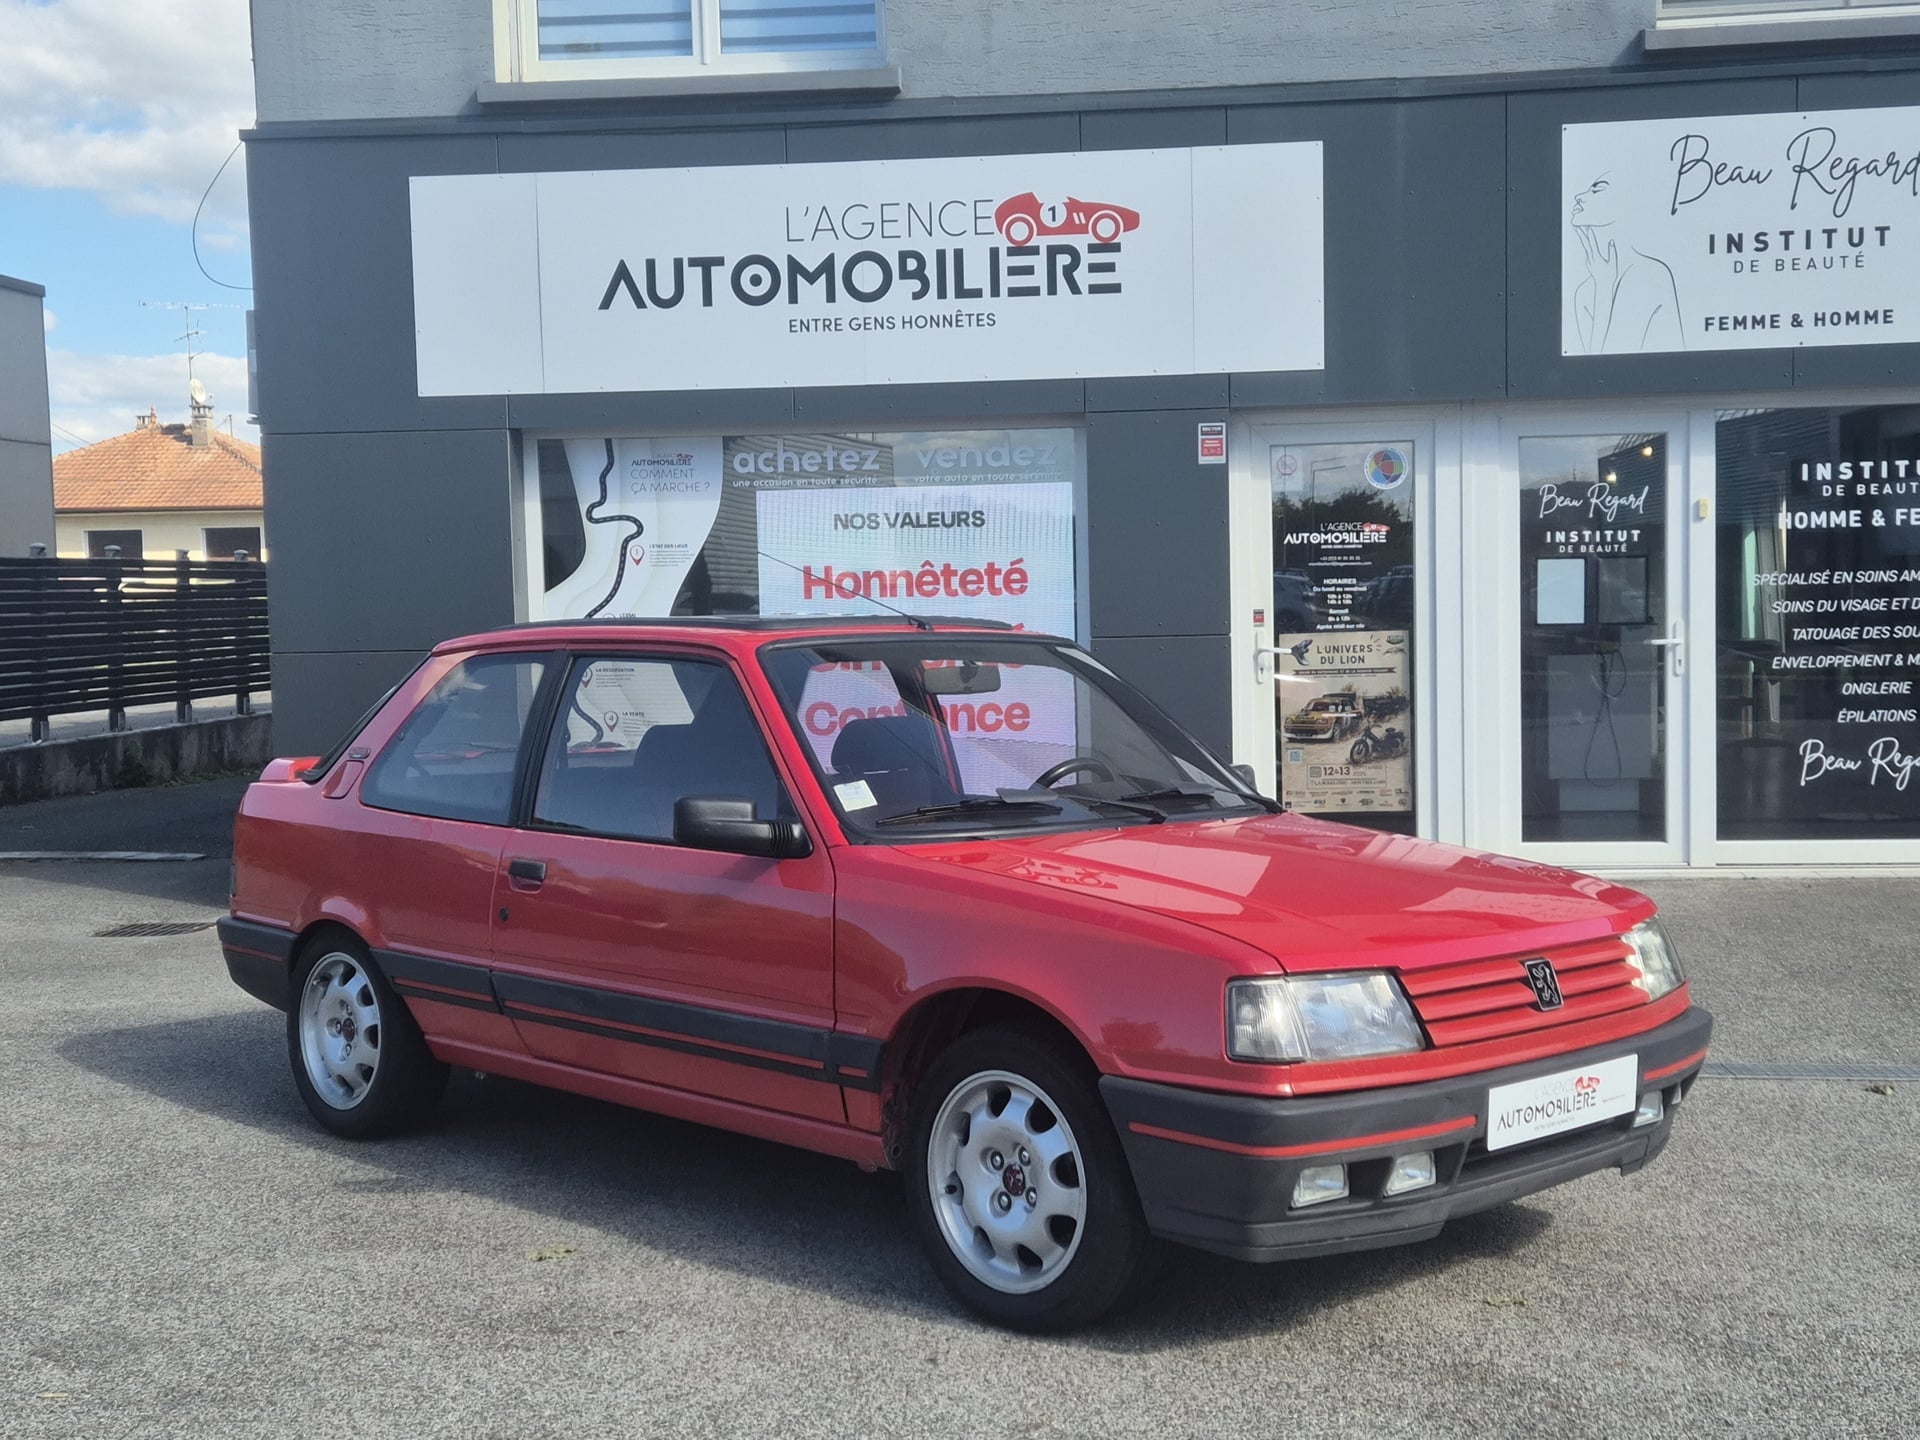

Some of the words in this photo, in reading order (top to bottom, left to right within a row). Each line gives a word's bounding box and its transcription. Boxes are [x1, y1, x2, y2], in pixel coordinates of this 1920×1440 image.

[1670, 134, 1773, 216] Beau
[785, 198, 995, 242] L'AGENCE
[1708, 225, 1891, 255] INSTITUT
[1733, 259, 1760, 274] DE
[1775, 251, 1865, 272] BEAUTÉ
[789, 317, 844, 333] ENTRE
[849, 315, 896, 332] GENS
[901, 310, 997, 330] HONNÊTES
[1704, 313, 1781, 331] FEMME
[1790, 312, 1804, 328] &
[1813, 308, 1895, 327] HOMME
[733, 438, 880, 474] achetez
[917, 432, 1057, 468] vendez
[630, 468, 695, 480] COMMENT
[753, 476, 793, 487] occasion
[811, 477, 837, 486] toute
[914, 473, 941, 482] votre
[944, 473, 967, 482] auto
[987, 472, 1016, 481] toute
[630, 482, 647, 495] ÇA
[649, 482, 700, 493] MARCHE
[704, 481, 711, 492] ?
[1822, 484, 1845, 496] DE
[1539, 483, 1584, 519] Beau
[1587, 482, 1650, 522] Regard
[833, 513, 881, 530] NOS
[884, 510, 986, 530] VALEURS
[1320, 522, 1362, 531] L'AGENCE
[1778, 510, 1862, 529] HOMME
[1871, 508, 1886, 527] &
[1895, 508, 1920, 527] FE
[1546, 529, 1641, 543] INSTITUT
[1558, 544, 1574, 553] DE
[1580, 542, 1628, 553] BEAUTÉ
[803, 557, 1029, 600] Honnêteté
[1753, 568, 1831, 586] SPÉCIALISÉ
[1833, 571, 1853, 584] EN
[1855, 569, 1899, 583] SOINS
[1772, 600, 1814, 614] SOINS
[1817, 599, 1837, 613] DU
[1840, 598, 1889, 612] VISAGE
[1891, 597, 1910, 610] ET
[1792, 625, 1860, 641] TATOUAGE
[1862, 625, 1891, 639] DES
[1320, 656, 1334, 665] DU
[1340, 655, 1366, 665] LION
[1771, 653, 1893, 669] ENVELOPPEMENT
[1894, 653, 1904, 666] &
[1842, 680, 1913, 695] ONGLERIE
[1837, 707, 1917, 723] ÉPILATIONS
[1799, 738, 1862, 786] Beau
